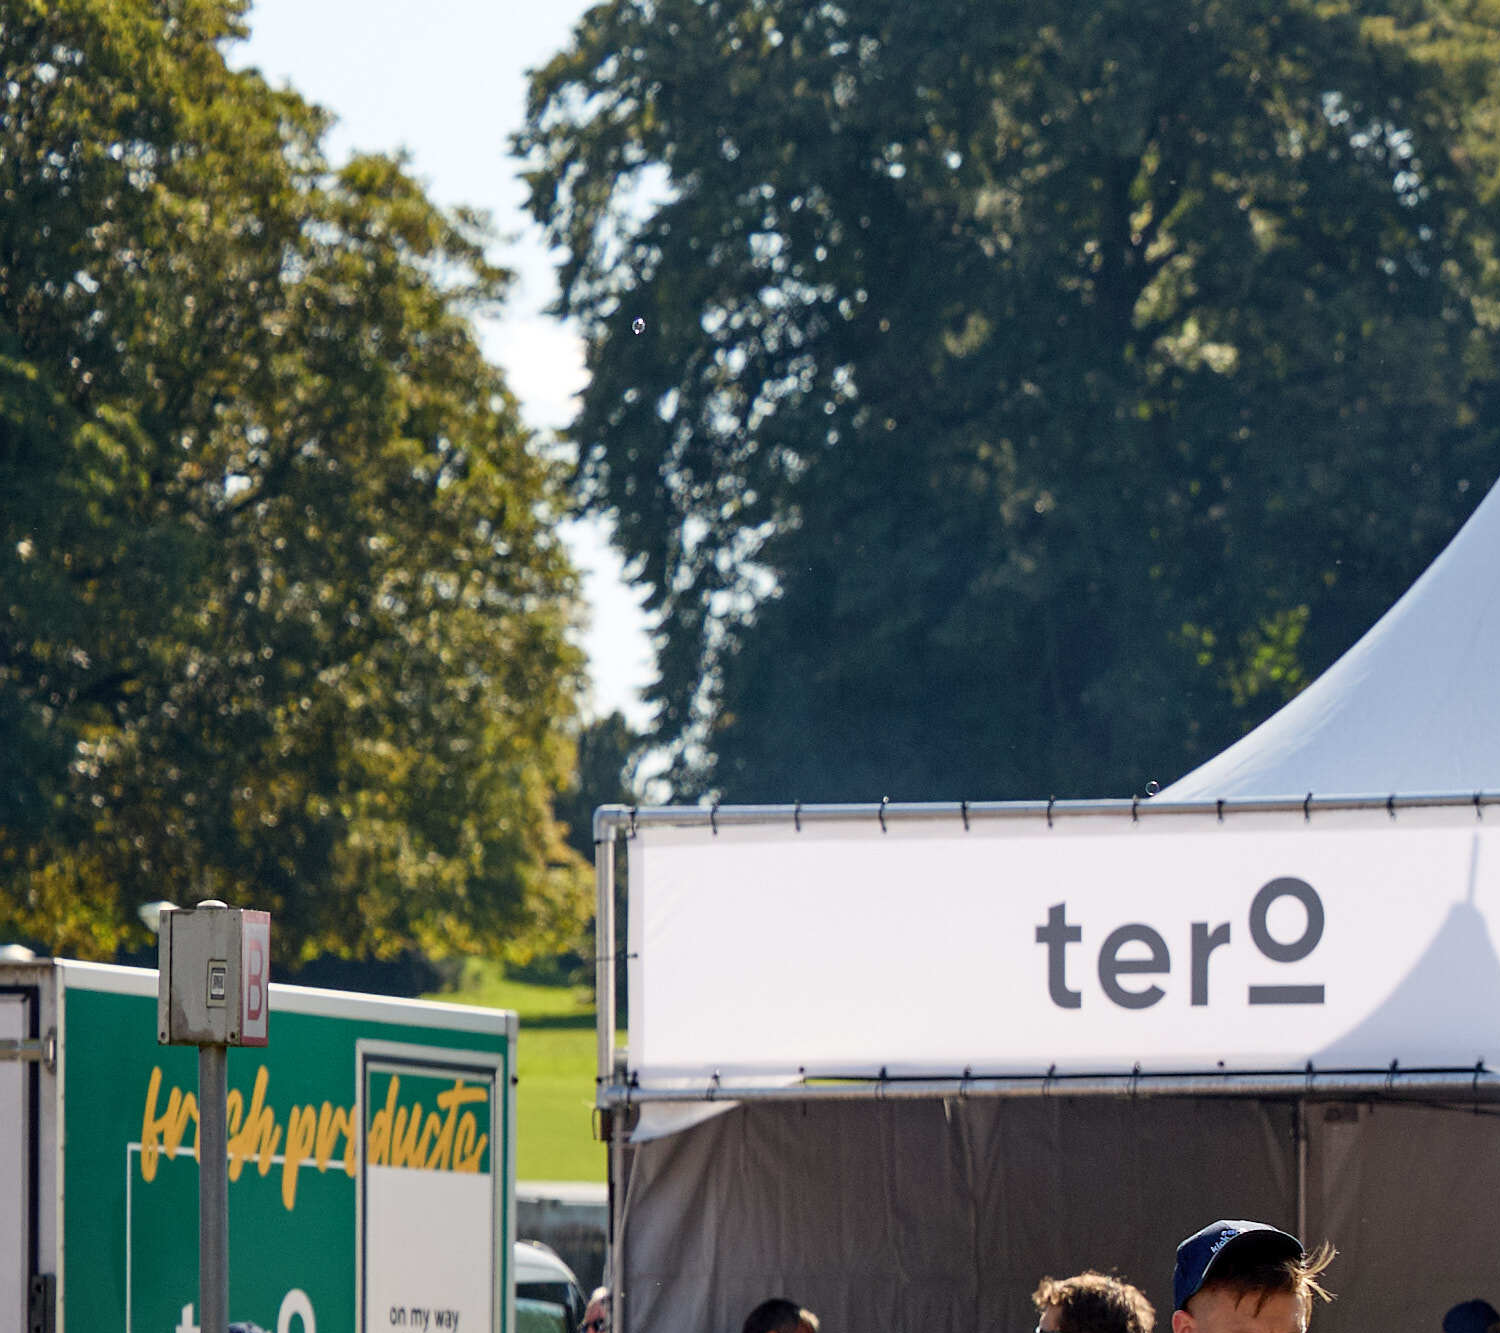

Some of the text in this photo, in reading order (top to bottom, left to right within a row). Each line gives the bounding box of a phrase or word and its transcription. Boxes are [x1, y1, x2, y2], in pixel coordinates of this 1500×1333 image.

[141, 1065, 282, 1183] frsh
[389, 1307, 460, 1332] on my way
